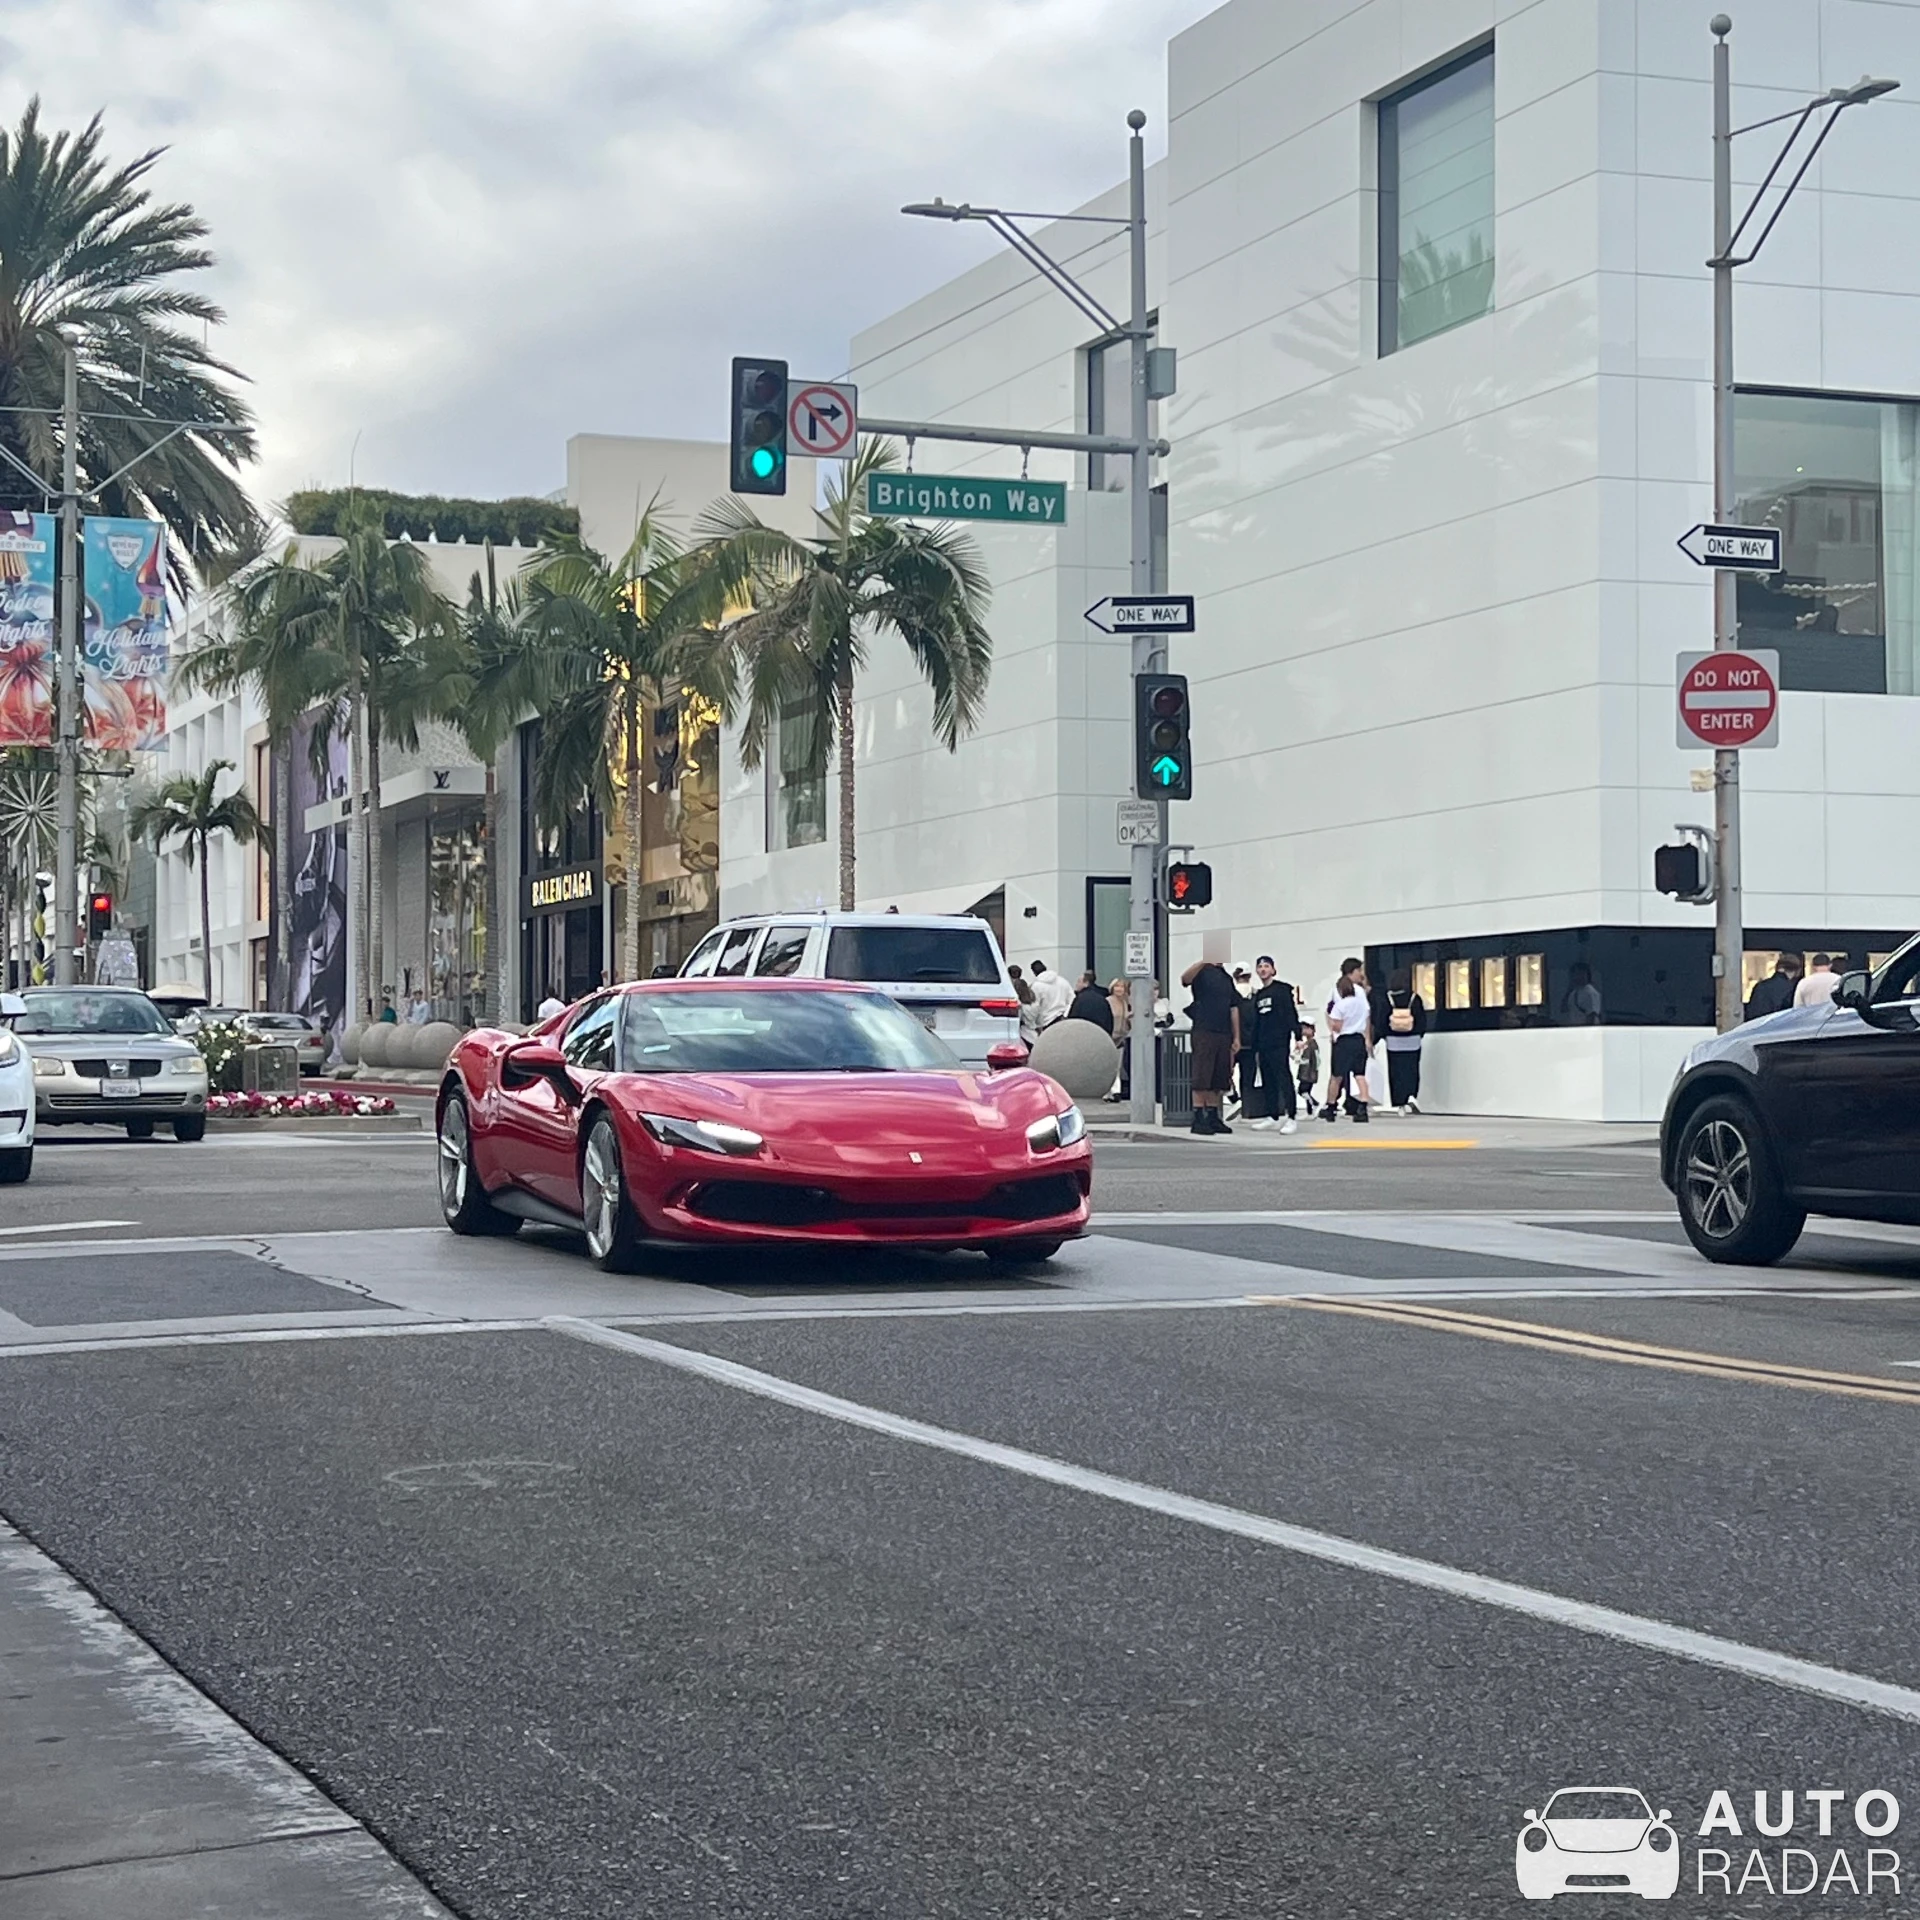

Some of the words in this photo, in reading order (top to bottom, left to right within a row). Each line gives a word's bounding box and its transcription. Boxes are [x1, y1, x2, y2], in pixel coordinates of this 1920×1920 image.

[877, 482, 991, 514] Brighton
[1007, 489, 1057, 519] Way
[1707, 537, 1735, 555] ONE
[1740, 540, 1768, 557] WAY
[1116, 607, 1146, 622] ONE
[1151, 606, 1181, 622] WAY
[0, 620, 49, 653] ights
[86, 627, 161, 658] Holiday
[99, 652, 163, 680] Lights
[1693, 670, 1718, 687] DO
[1727, 669, 1761, 687] NOT
[1700, 712, 1754, 730] ENTER
[1120, 826, 1137, 840] OK
[532, 870, 593, 907] BALENCIAGA
